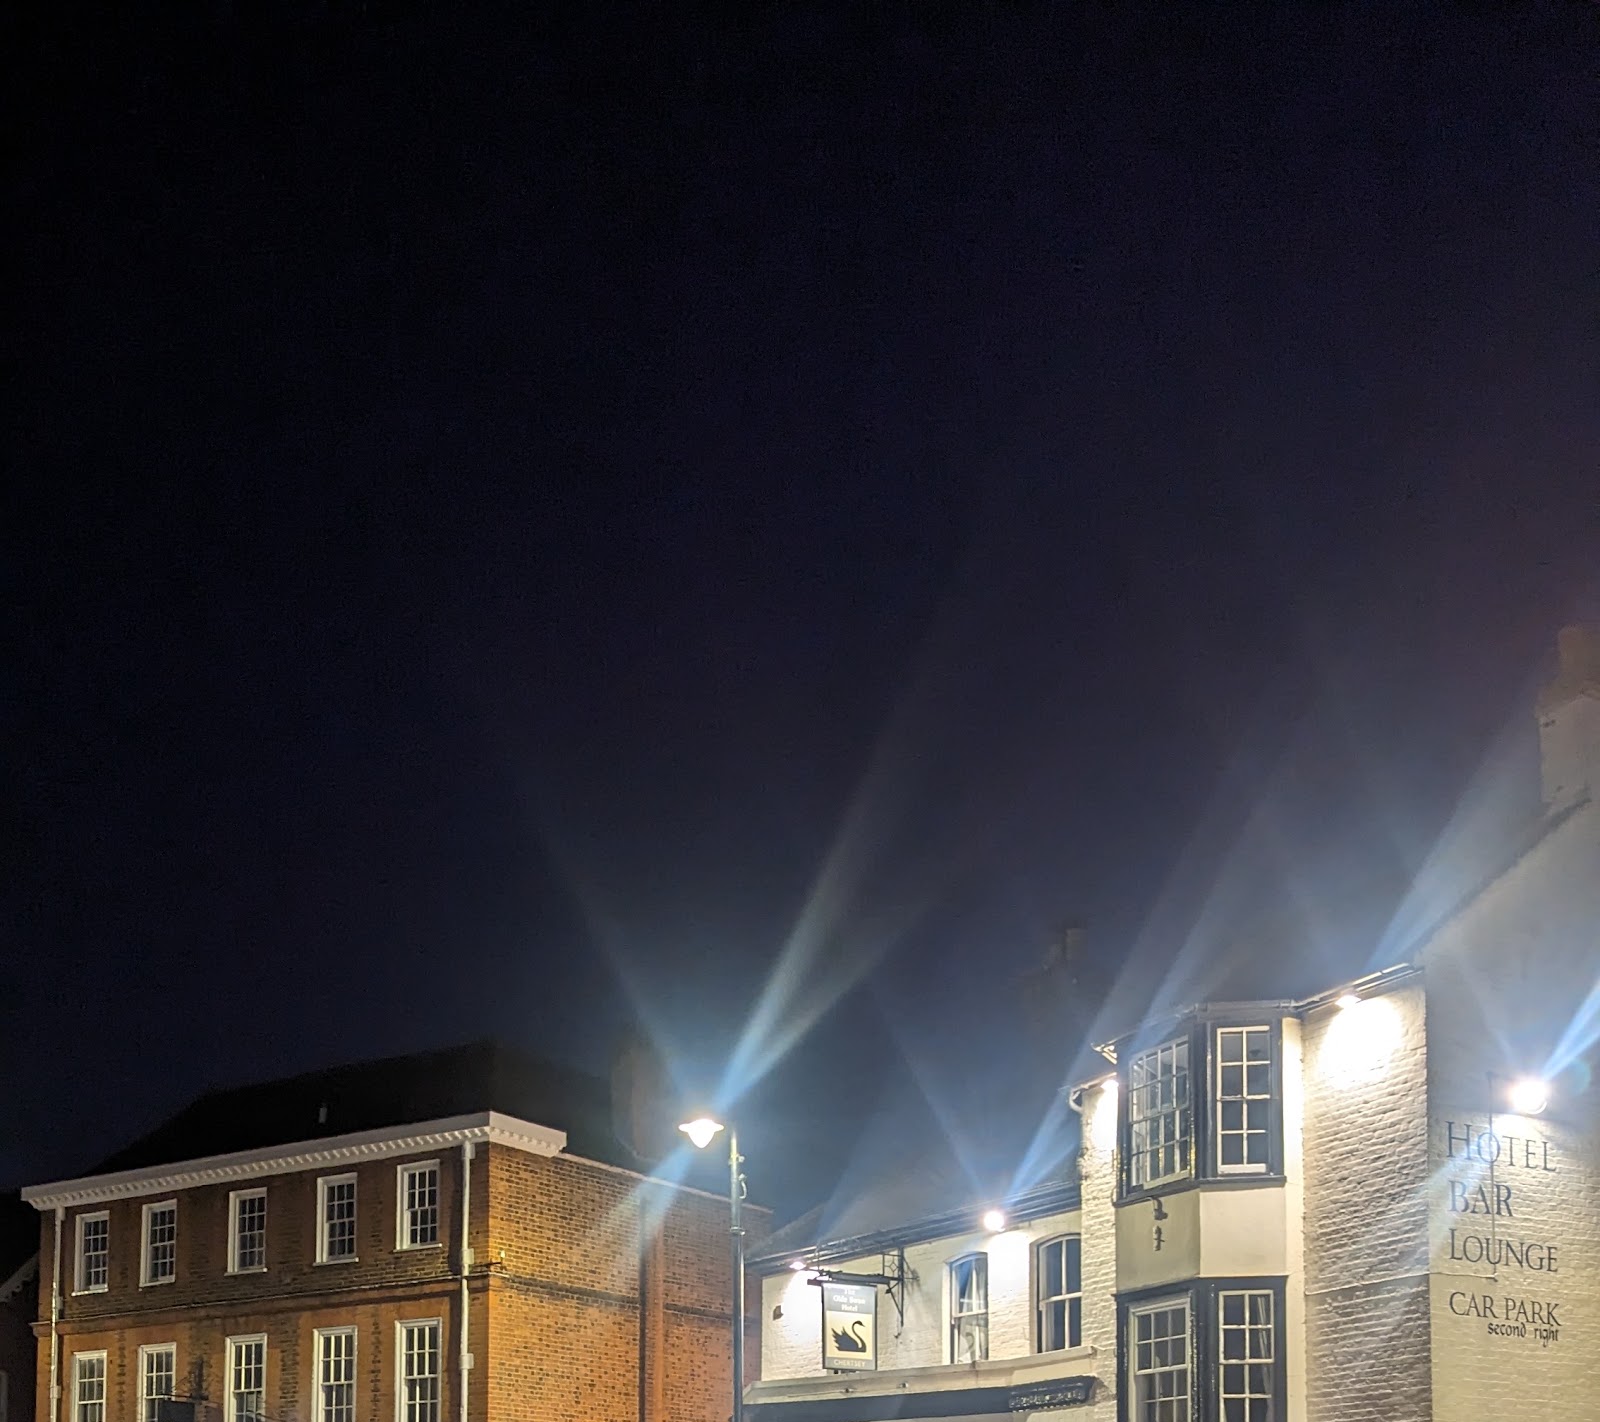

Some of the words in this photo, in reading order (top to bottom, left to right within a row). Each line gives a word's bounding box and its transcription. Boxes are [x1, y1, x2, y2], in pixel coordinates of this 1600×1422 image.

[1445, 1120, 1557, 1172] HOTEL
[1449, 1180, 1513, 1217] BAR
[1448, 1228, 1559, 1273] LOUNGE
[1449, 1291, 1498, 1319] CAR
[1504, 1297, 1562, 1327] PARK
[1487, 1322, 1527, 1340] second
[1533, 1326, 1559, 1348] right
